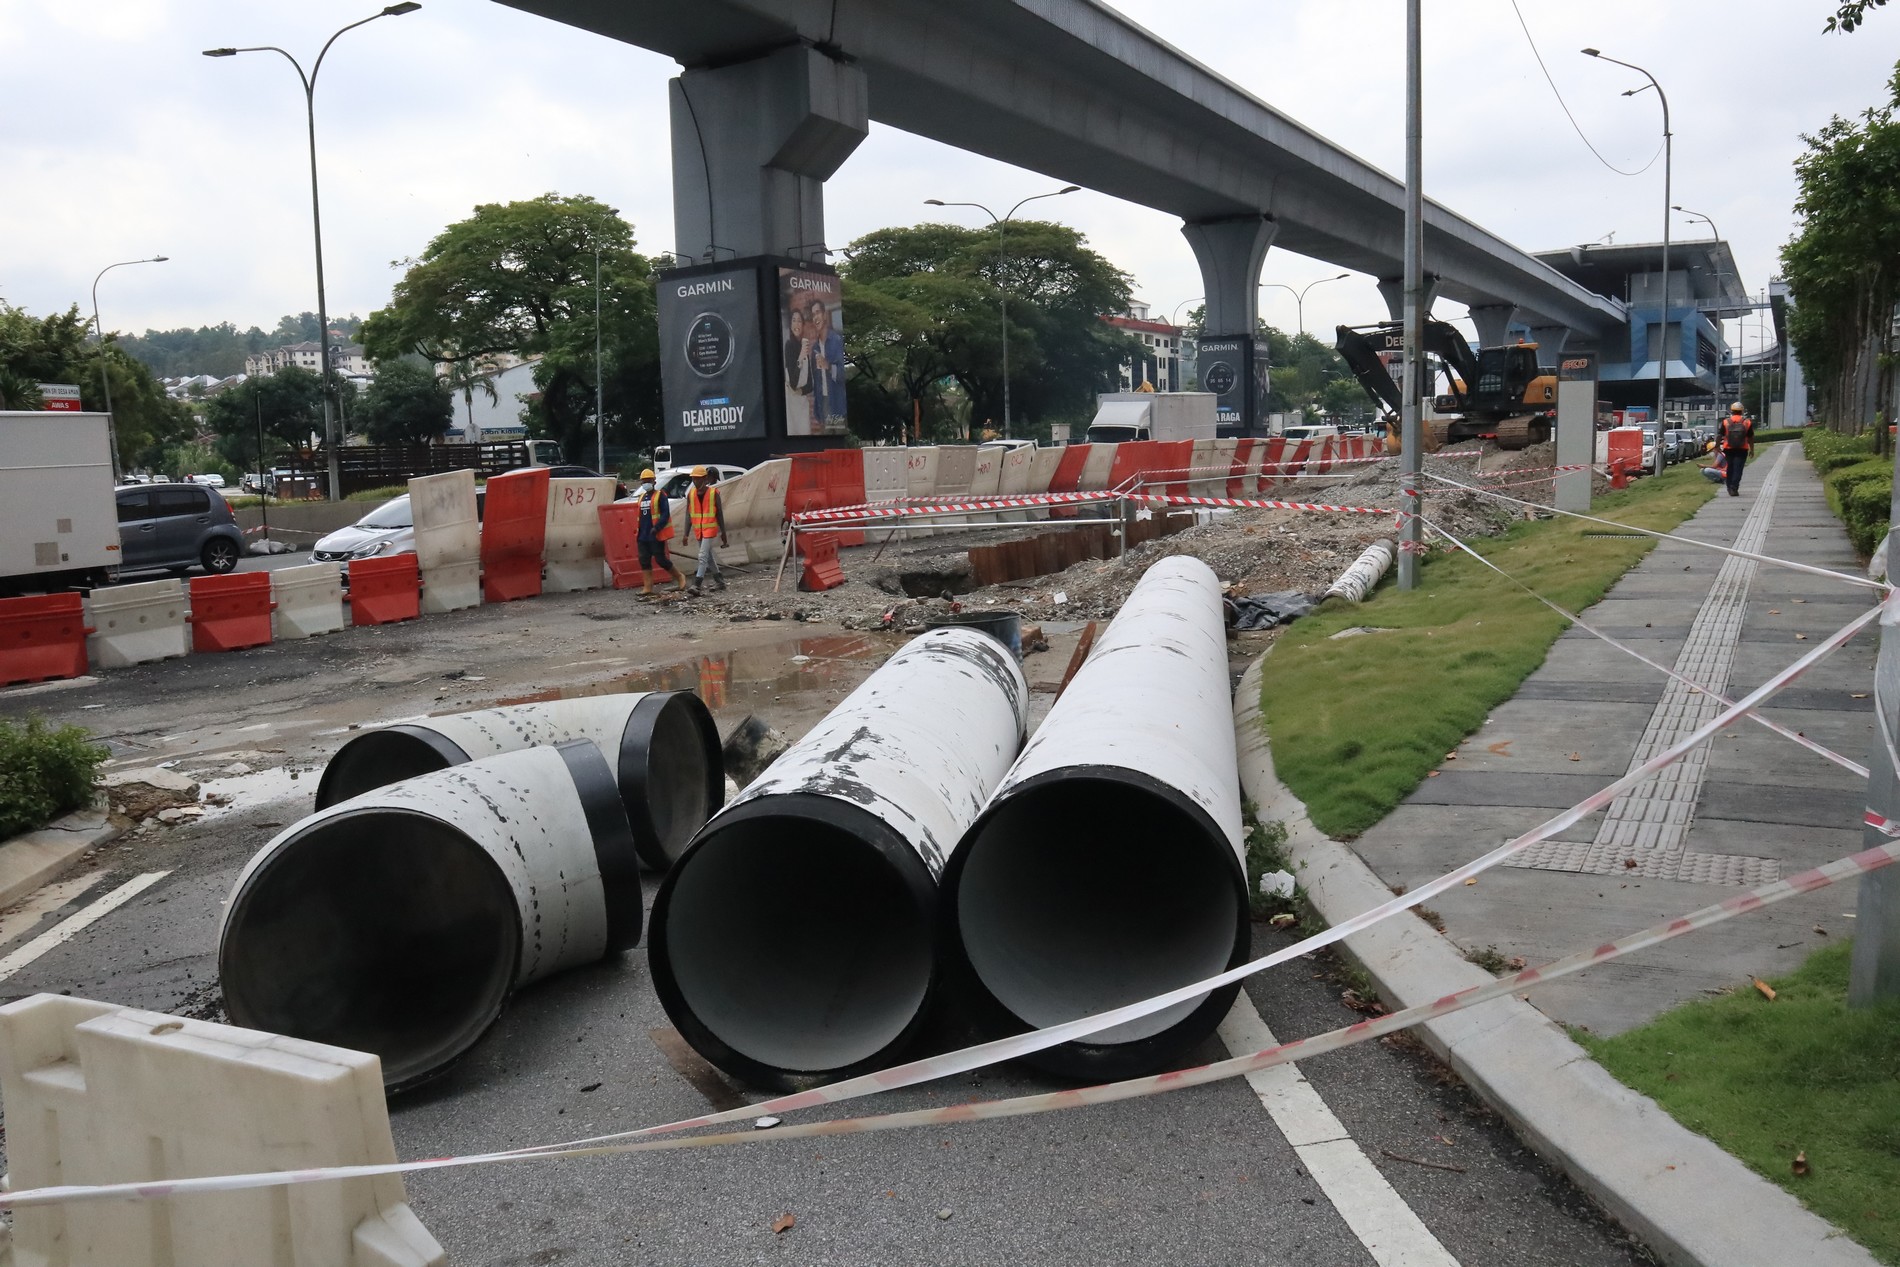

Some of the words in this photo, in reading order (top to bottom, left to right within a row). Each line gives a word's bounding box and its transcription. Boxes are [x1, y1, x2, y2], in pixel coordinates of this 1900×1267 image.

[677, 279, 732, 298] GARMIN
[789, 276, 832, 293] GARMIN
[1201, 344, 1238, 352] GARMIN
[1385, 335, 1404, 347] DEE
[683, 409, 712, 427] DEAR
[712, 405, 744, 425] BODY
[1220, 412, 1241, 422] RAGA
[564, 487, 596, 507] RBJ
